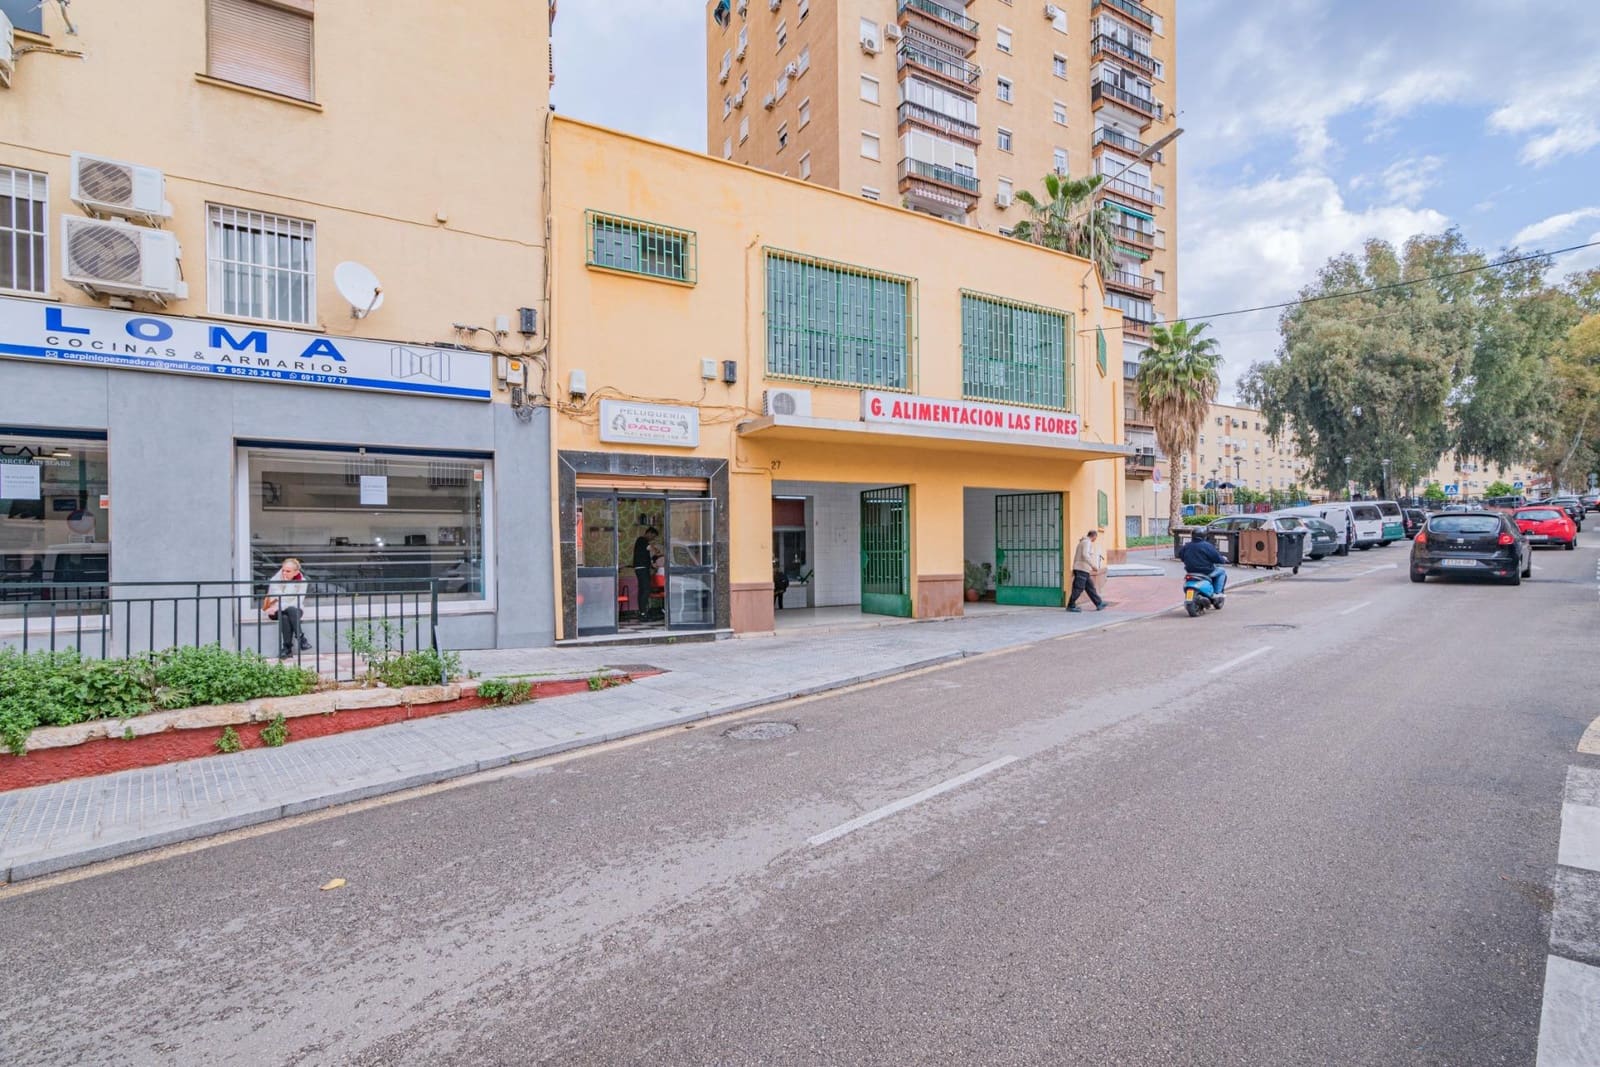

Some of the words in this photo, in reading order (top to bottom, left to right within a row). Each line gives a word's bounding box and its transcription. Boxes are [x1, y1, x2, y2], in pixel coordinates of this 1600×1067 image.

[45, 307, 346, 362] LOMA
[46, 336, 176, 358] COCINAS
[194, 351, 205, 361] &
[221, 354, 348, 375] ARMARIOS
[627, 422, 672, 433] PACO
[891, 400, 1004, 428] ALIMENTACION
[1007, 412, 1031, 431] LAS
[1034, 415, 1078, 436] FLORES
[771, 460, 782, 470] 27
